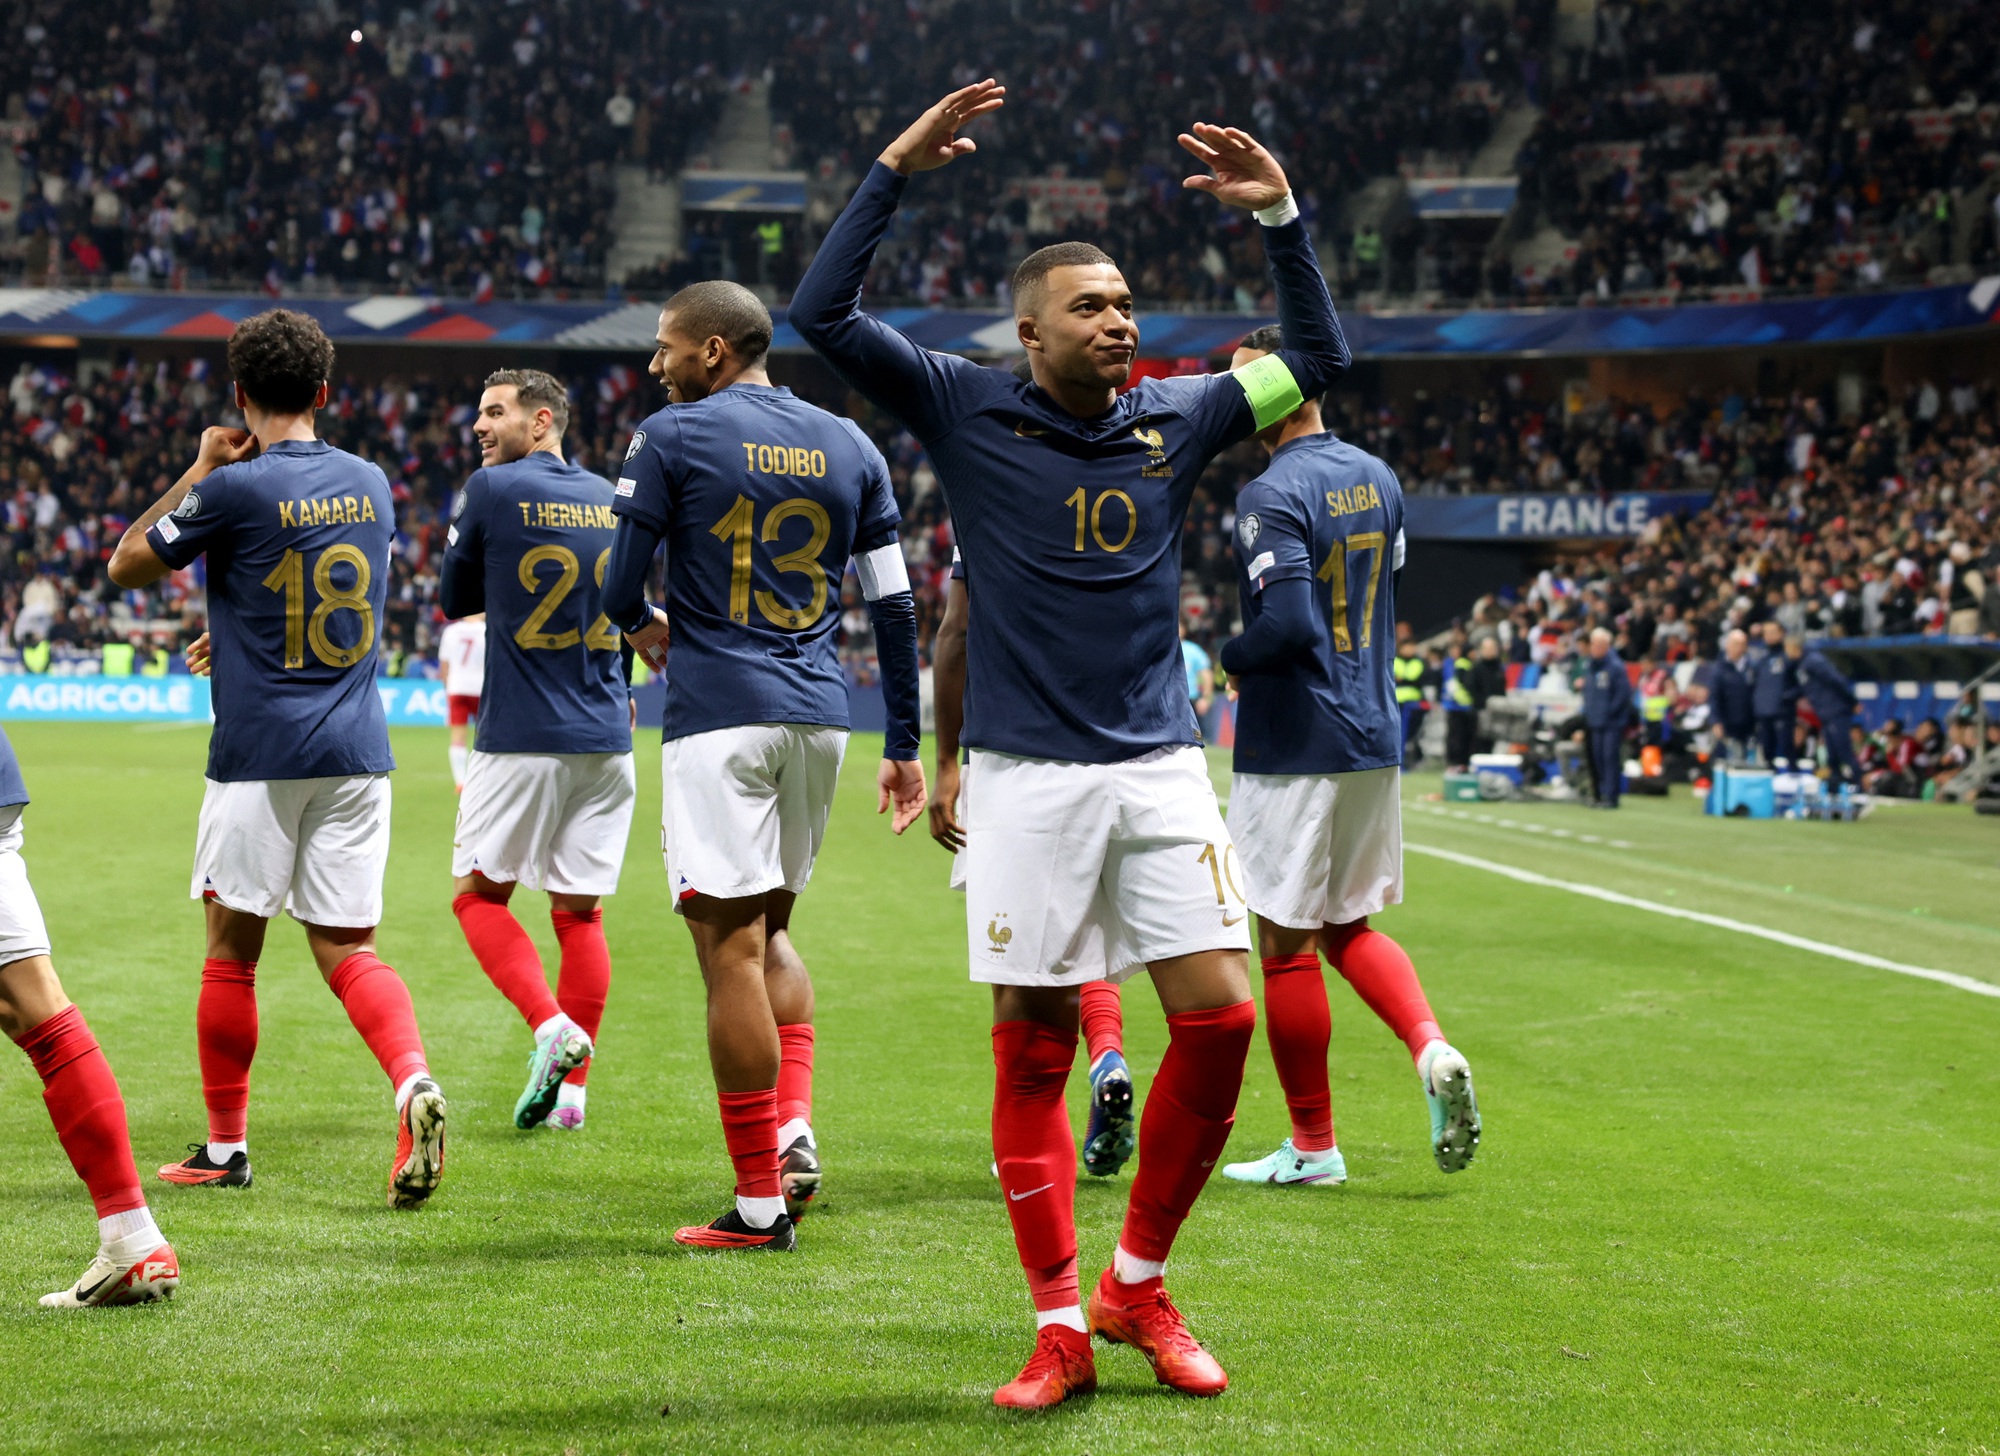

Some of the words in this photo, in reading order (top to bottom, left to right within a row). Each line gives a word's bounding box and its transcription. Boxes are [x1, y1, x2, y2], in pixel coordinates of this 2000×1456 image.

[742, 442, 827, 478] TODIBO
[278, 495, 376, 528] KAMARA
[1326, 483, 1382, 517] SALIBA
[1498, 497, 1649, 534] FRANCE
[1064, 486, 1137, 553] 10
[708, 493, 831, 630] 13
[262, 543, 375, 669] 18
[1316, 531, 1387, 653] 17
[462, 639, 475, 668] 7
[7, 682, 193, 713] AGRICOLE
